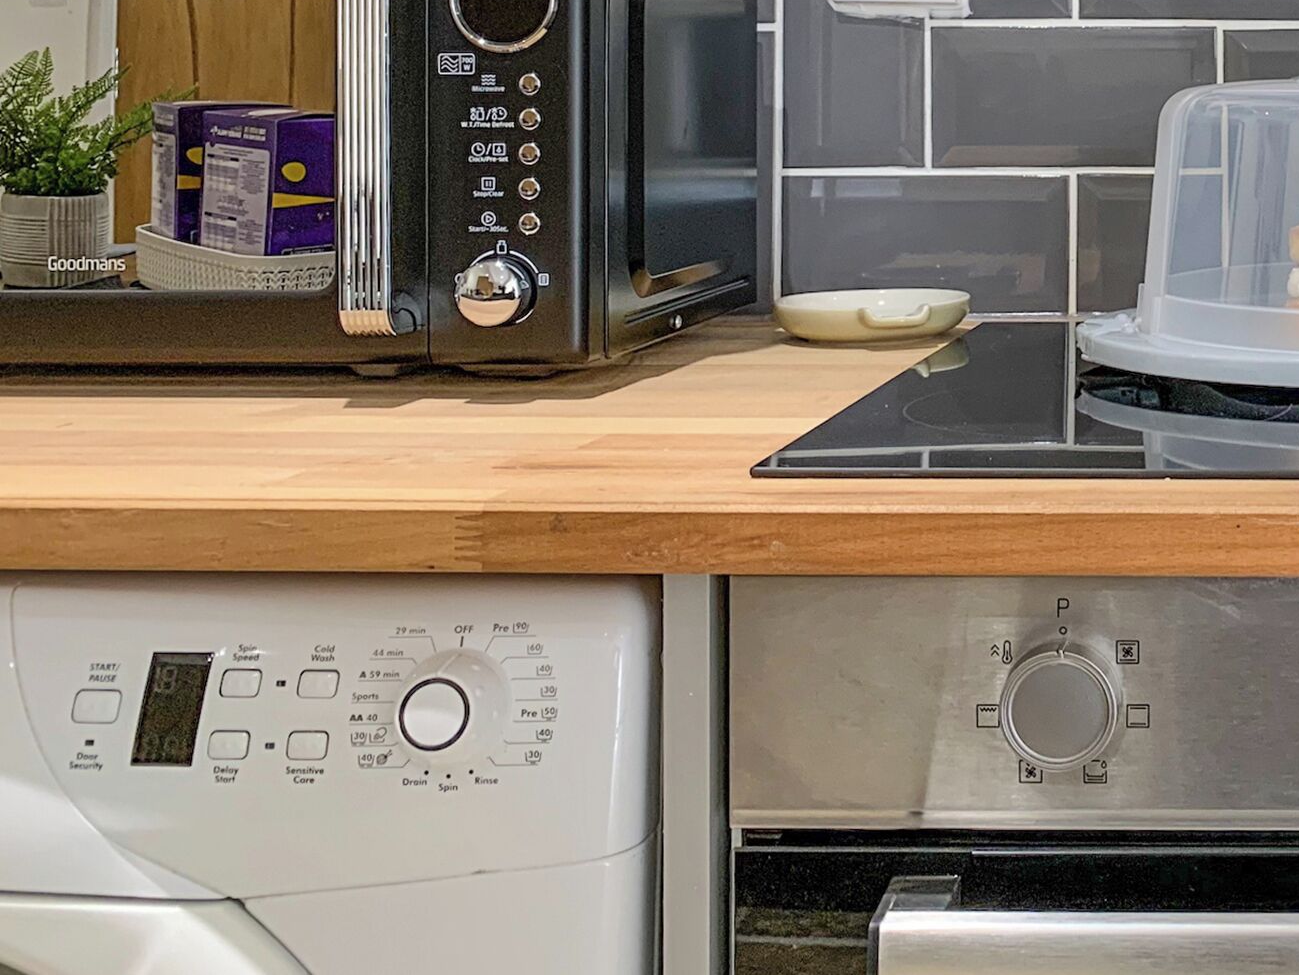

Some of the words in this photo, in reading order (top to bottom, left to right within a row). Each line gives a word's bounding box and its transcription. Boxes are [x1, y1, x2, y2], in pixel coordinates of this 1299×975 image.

[471, 85, 506, 93] Microwave
[491, 121, 515, 129] Defrost
[47, 255, 127, 272] Goodmans
[1056, 597, 1070, 618] P
[395, 627, 408, 635] 29
[409, 627, 426, 635] min
[454, 625, 474, 634] OFF
[493, 623, 509, 632] Pre
[238, 644, 258, 654] Spin
[314, 645, 335, 654] Cold
[529, 644, 542, 652] 60
[232, 653, 259, 662] Speed
[311, 653, 335, 662] Wash
[372, 649, 385, 657] 44
[386, 649, 404, 657] min
[539, 665, 551, 673] 40
[88, 674, 117, 683] PAUSE
[358, 670, 367, 679] A
[369, 670, 381, 679] 59
[543, 686, 555, 694] 30
[351, 692, 379, 702] Sports
[520, 709, 538, 718] Pre
[544, 707, 556, 715] 50
[349, 714, 364, 722] AA
[366, 714, 378, 722] 40
[353, 732, 365, 740] 30
[539, 728, 551, 737] 40
[76, 752, 99, 761] Door
[361, 754, 373, 762] 40
[527, 751, 539, 759] 30
[69, 761, 103, 772] Security
[213, 766, 239, 776] Delay
[285, 766, 324, 775] Sensitive
[214, 775, 236, 784] Start
[293, 775, 315, 784] Care
[402, 778, 428, 787] Drain
[474, 776, 499, 786] Rinse
[438, 783, 459, 793] Spin
